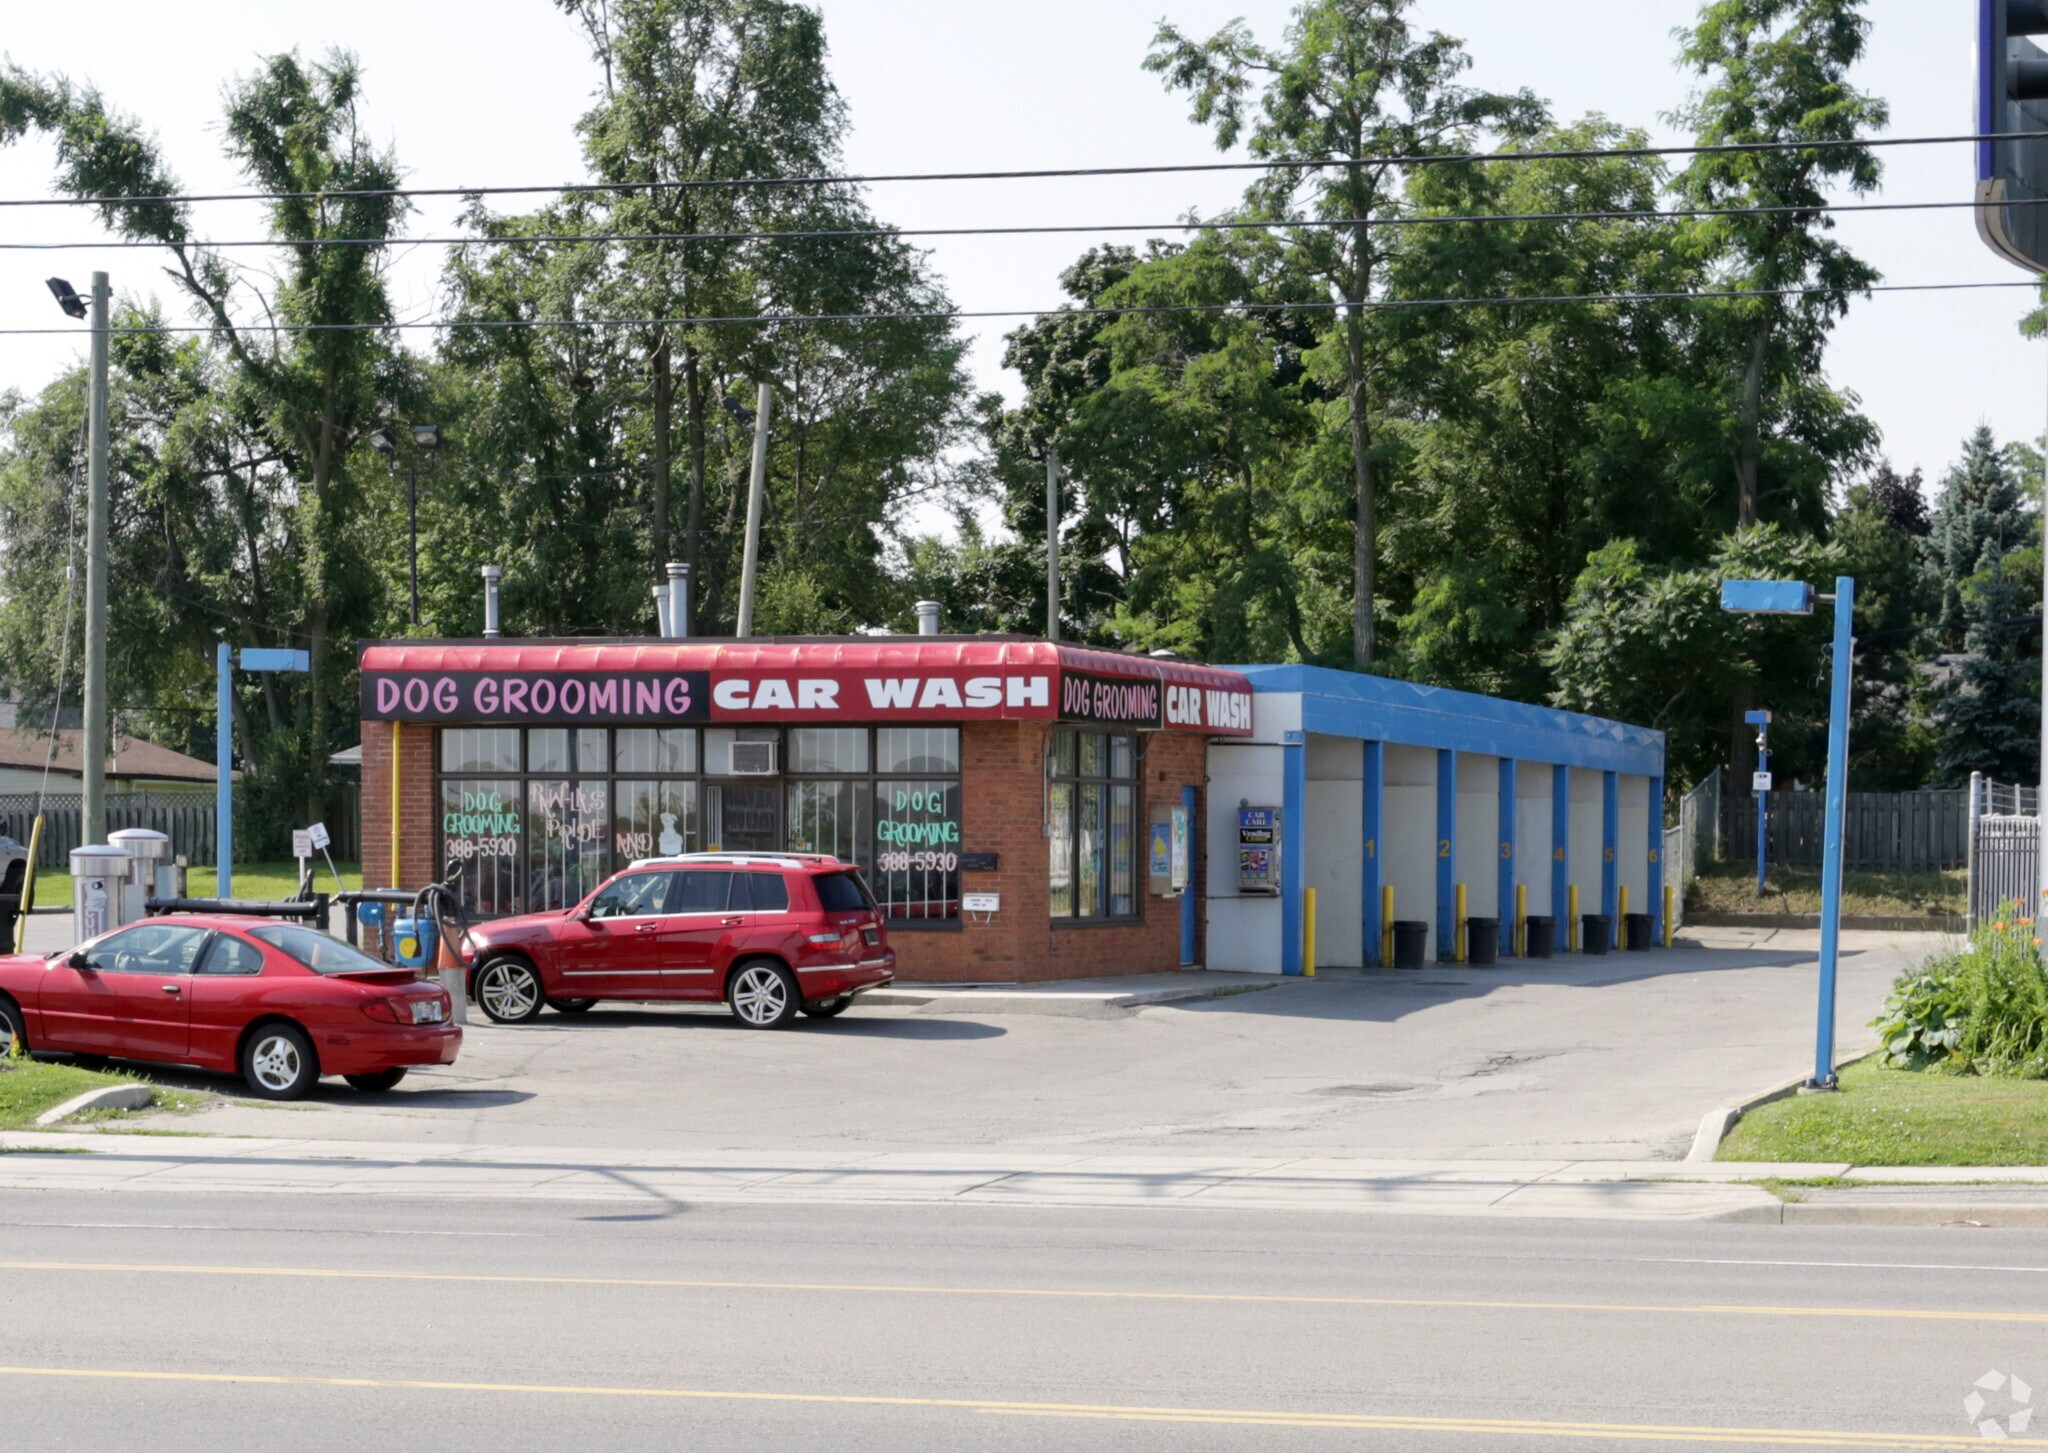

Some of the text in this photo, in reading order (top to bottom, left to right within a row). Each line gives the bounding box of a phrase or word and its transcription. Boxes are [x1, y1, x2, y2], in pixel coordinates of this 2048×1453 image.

[376, 677, 692, 715] DOG GROOMING
[713, 676, 1049, 709] CAR WASH
[1064, 676, 1158, 720] DOG GROOMING
[1166, 685, 1251, 729] CAR WASH
[464, 792, 502, 812] DOG
[896, 790, 942, 813] DOG
[443, 813, 520, 838] GROOMING
[1248, 811, 1265, 819] CAR
[546, 818, 605, 850] PRIDE
[877, 820, 959, 847] GROOMING
[1365, 840, 1375, 857] 1
[1439, 840, 1450, 857] 2
[1500, 842, 1512, 859] 3
[1553, 847, 1565, 862] 4
[1603, 847, 1614, 862] 5
[1648, 849, 1658, 862] 6
